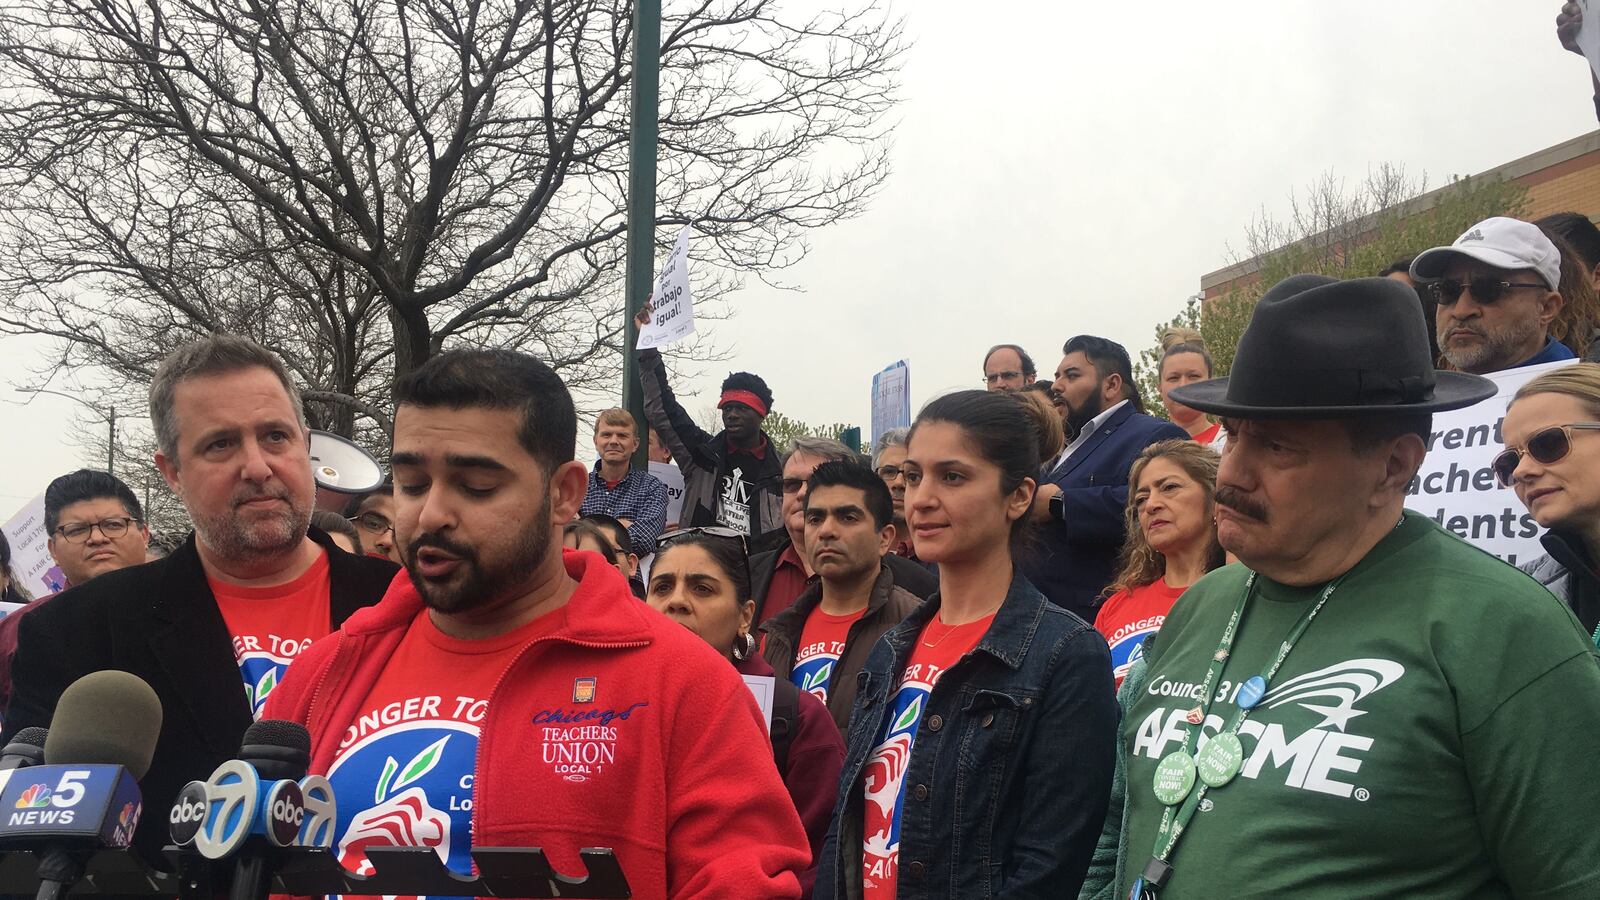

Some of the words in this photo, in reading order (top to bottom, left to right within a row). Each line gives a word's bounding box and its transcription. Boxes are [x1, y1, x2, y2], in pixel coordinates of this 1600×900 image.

[653, 285, 683, 311] trabajo
[656, 301, 683, 327] igual!
[1427, 417, 1504, 452] rent
[1403, 463, 1506, 496] ache
[12, 516, 35, 538] Support
[1432, 508, 1539, 539] dents
[18, 535, 34, 551] Local
[35, 543, 46, 553] For
[33, 559, 47, 573] FAIR
[532, 701, 649, 726] Chicago
[542, 726, 617, 741] TEACHERS
[542, 742, 616, 764] UNION
[1212, 744, 1233, 762] FAIR
[555, 765, 592, 773] LOCAL
[597, 766, 602, 774] 1
[1162, 768, 1184, 777] FAIR
[52, 771, 91, 808] 5
[1159, 781, 1182, 791] NOW!
[8, 810, 75, 826] NEWS
[170, 797, 205, 824] abc
[273, 795, 304, 826] abc
